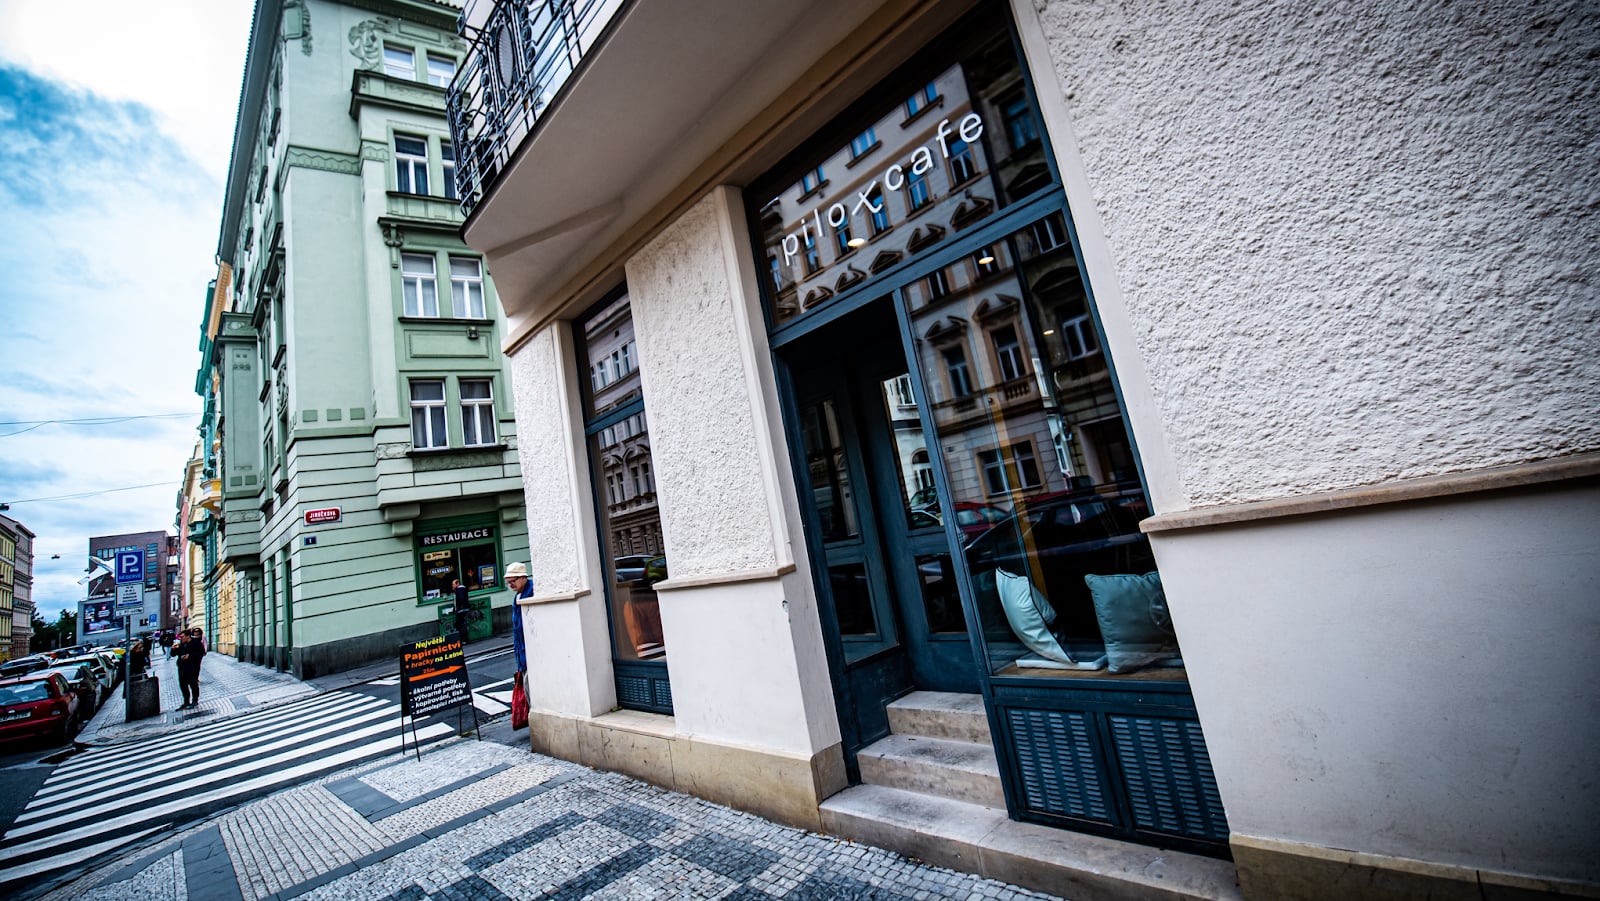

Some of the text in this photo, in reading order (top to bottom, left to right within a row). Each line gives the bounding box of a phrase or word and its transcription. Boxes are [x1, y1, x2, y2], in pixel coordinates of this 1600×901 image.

[782, 112, 983, 266] piloxcafe
[424, 529, 488, 545] RESTAURACE
[122, 554, 138, 574] P
[415, 636, 445, 649] Největší
[404, 640, 461, 662] Papírnictví
[413, 678, 457, 695] školní potřeby
[452, 689, 463, 697] tisk
[414, 689, 441, 701] výtvarné
